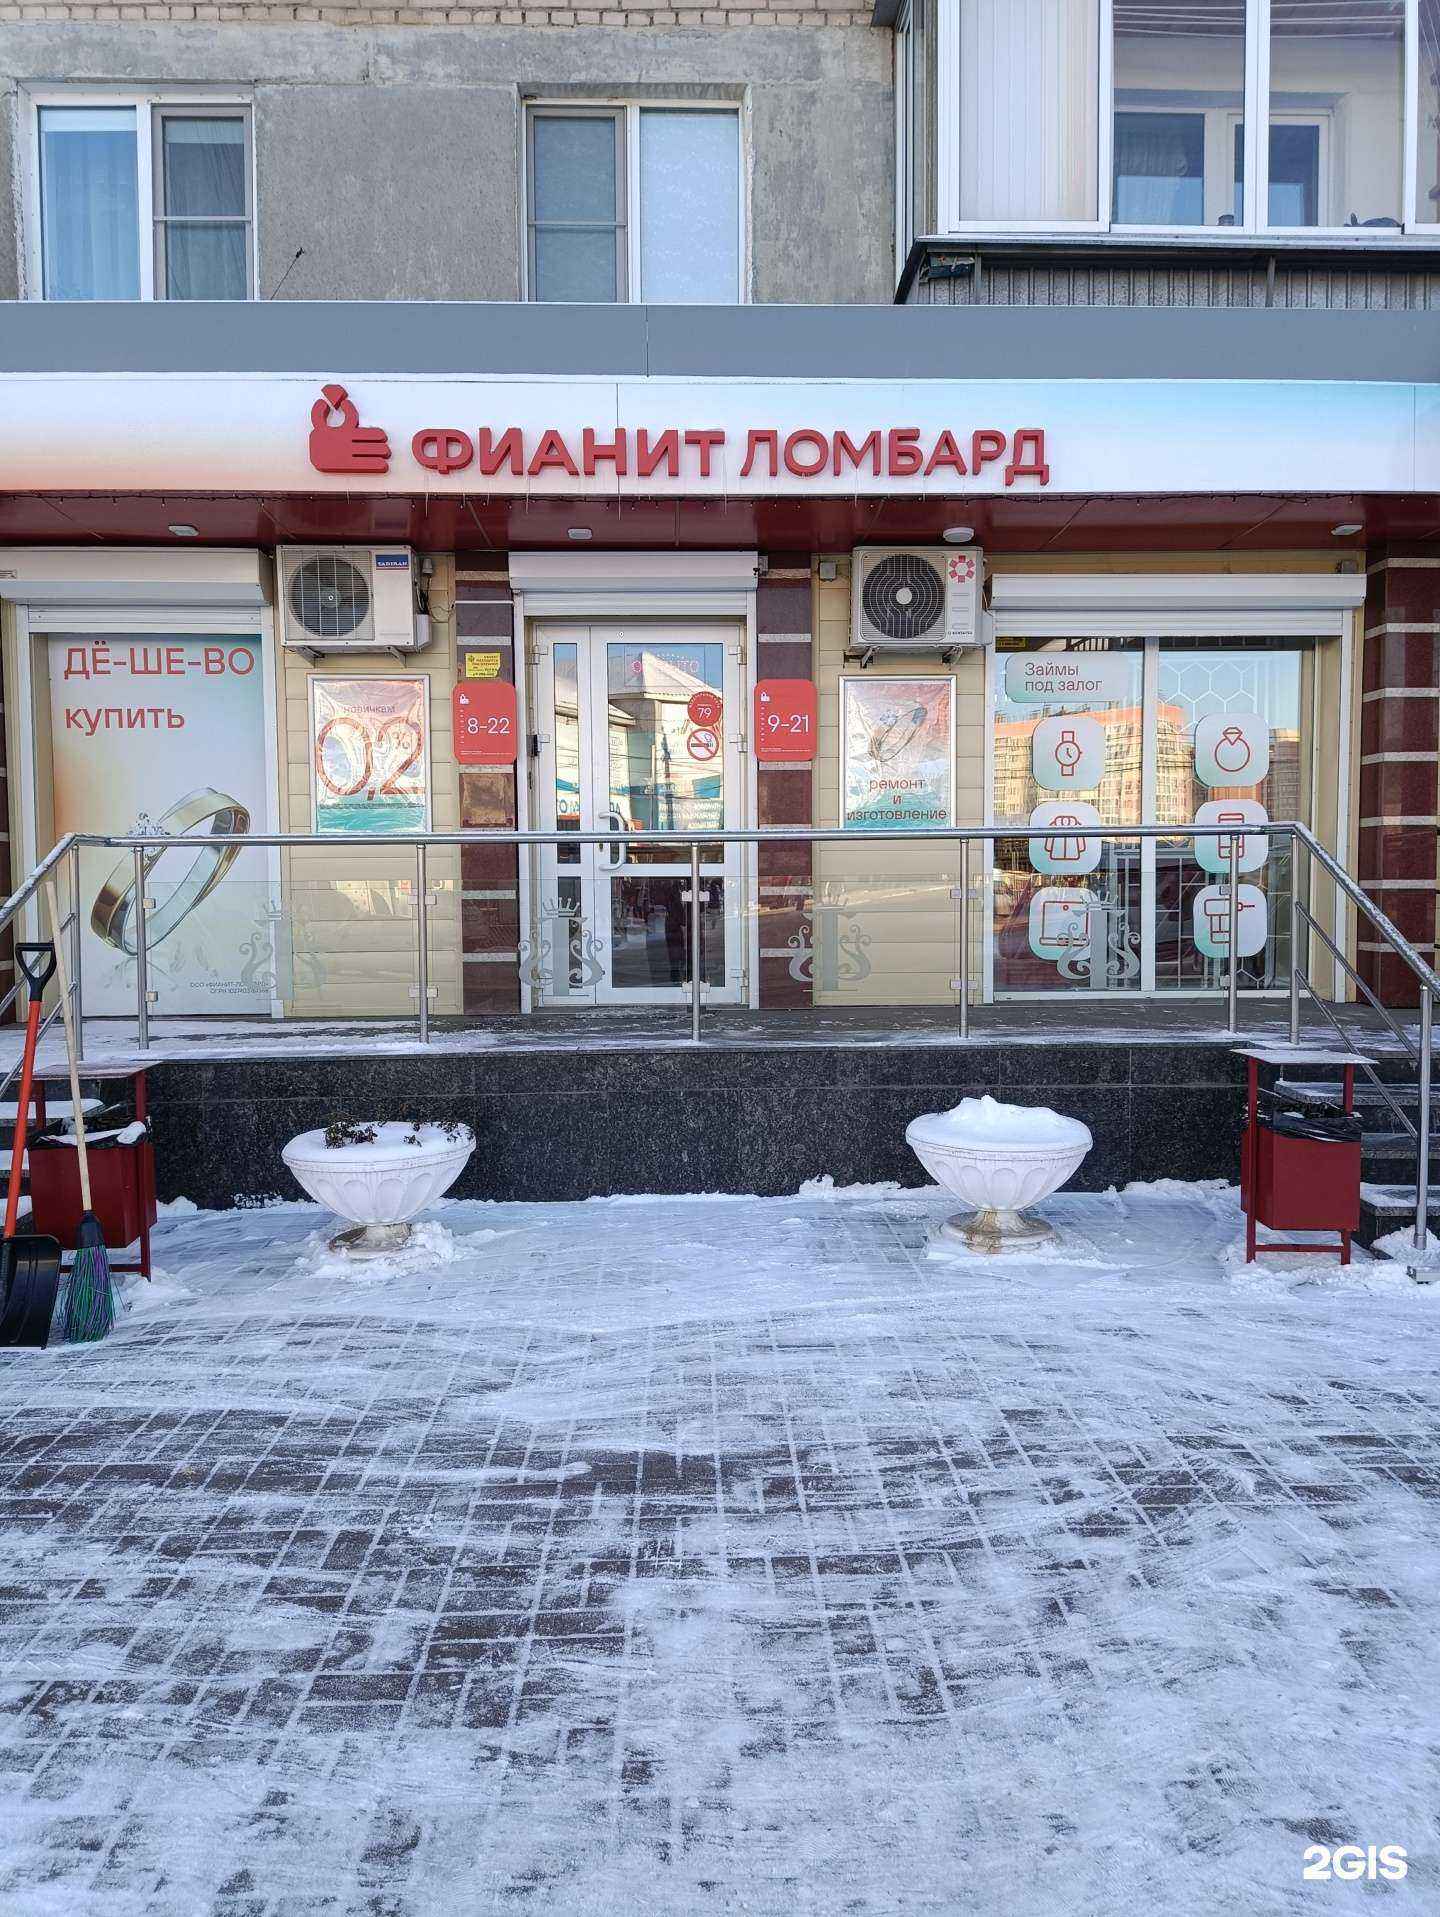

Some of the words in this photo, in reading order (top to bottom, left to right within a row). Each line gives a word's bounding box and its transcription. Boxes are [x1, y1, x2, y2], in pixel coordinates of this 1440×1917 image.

[411, 427, 726, 478] ФИАНИТ
[739, 427, 1050, 487] ЛОМБАРД
[64, 640, 255, 680] ДЁ-ШЕ-ВО
[1025, 660, 1079, 676] Займы
[1025, 680, 1054, 693] под
[1058, 680, 1103, 692] залог
[697, 706, 712, 719] 79
[65, 708, 186, 737] купить
[467, 717, 511, 734] 8-22
[767, 714, 809, 733] 9-21
[869, 779, 925, 792] ремонт
[893, 795, 902, 804] и
[847, 809, 947, 821] изготовление
